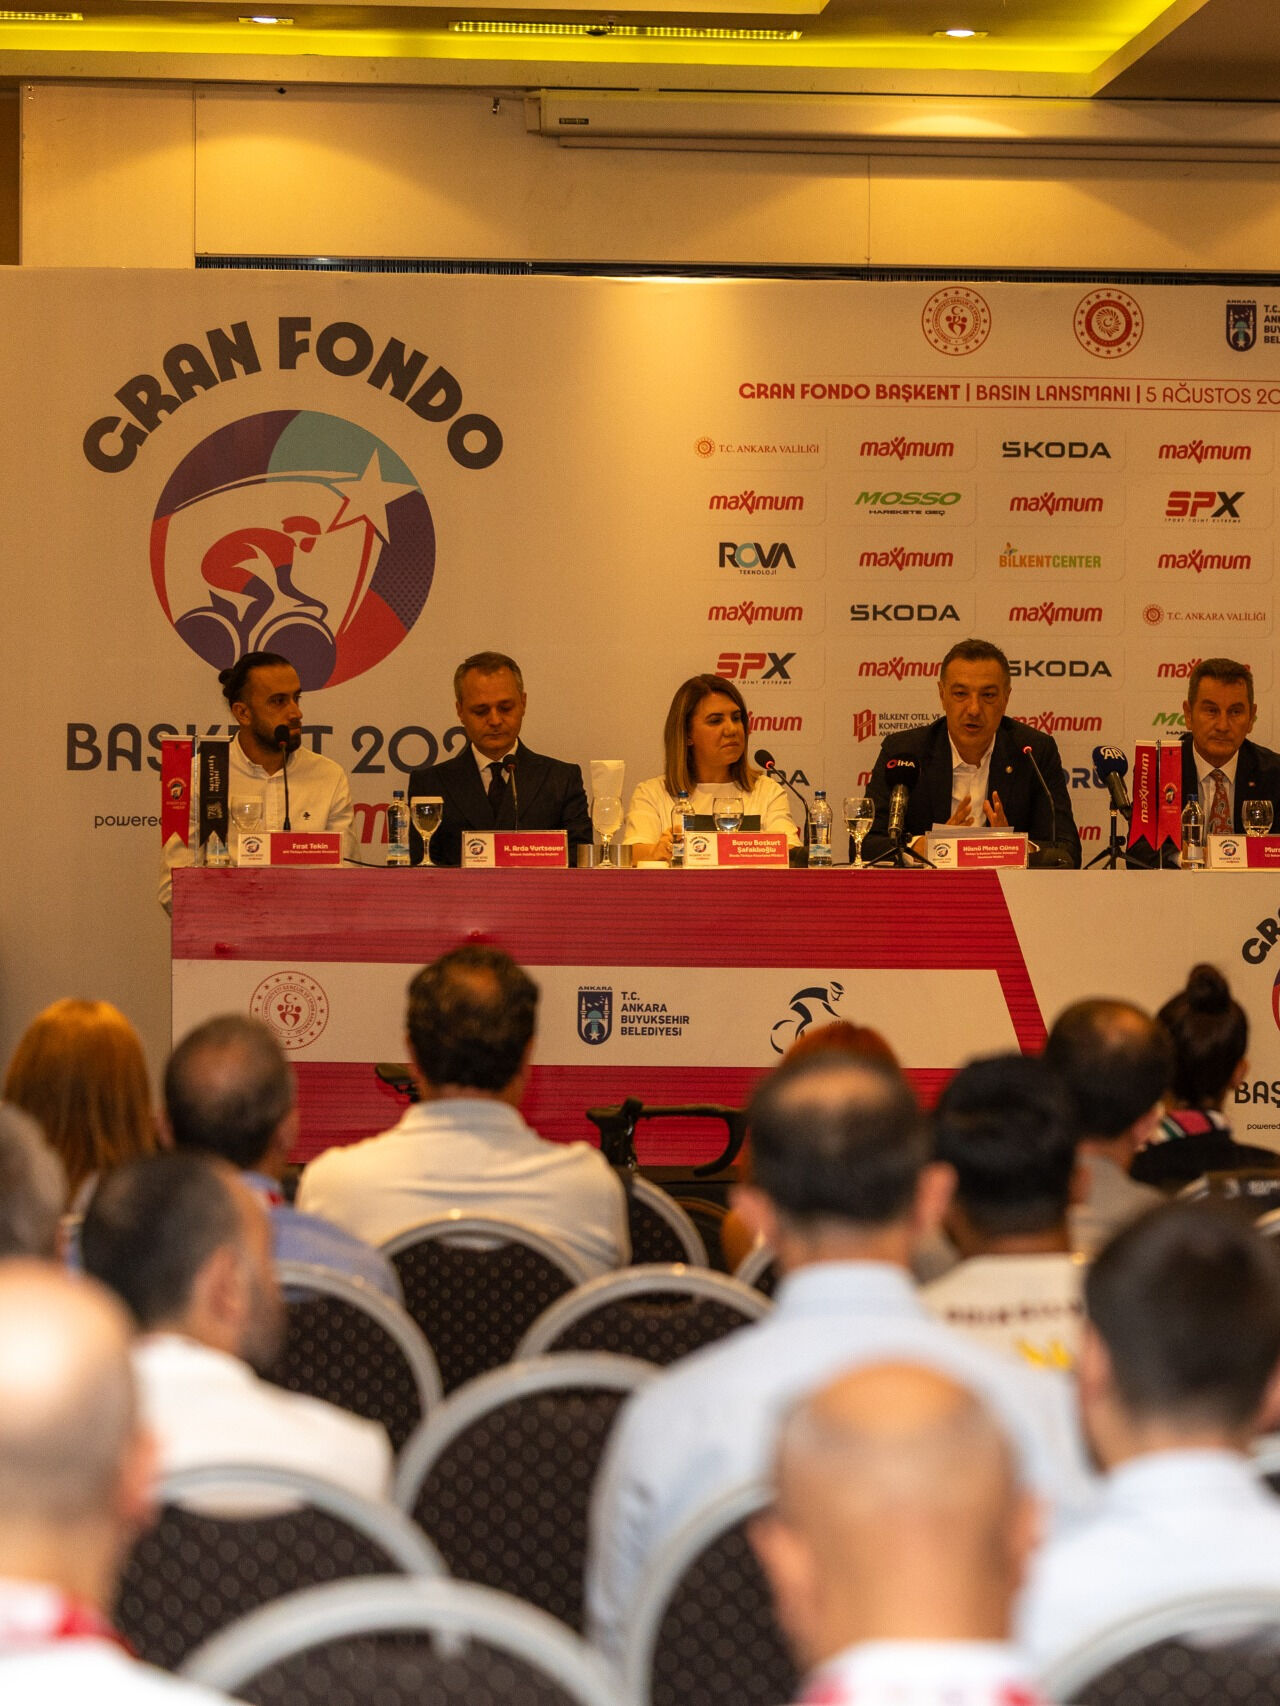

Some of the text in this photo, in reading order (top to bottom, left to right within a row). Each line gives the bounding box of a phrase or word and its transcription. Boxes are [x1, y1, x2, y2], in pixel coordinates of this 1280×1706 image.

[1263, 305, 1280, 313] T.C.
[82, 316, 505, 474] GRAN FONDO
[738, 382, 795, 400] GRAN
[800, 383, 871, 400] FONDO
[875, 383, 961, 403] BAŞKENT
[976, 384, 1031, 401] BASIN
[1036, 384, 1130, 402] LANSMANI
[1145, 386, 1157, 403] 5
[1162, 382, 1251, 404] AĞUSTOS
[736, 444, 778, 454] ANKARA
[854, 491, 962, 506] MOSSO
[1165, 490, 1246, 518] SPX
[718, 542, 797, 569] ROVA
[1185, 612, 1225, 622] ANKARA
[714, 652, 797, 680] SPX
[620, 991, 640, 1001] T.C.
[620, 1003, 668, 1013] ANKARA
